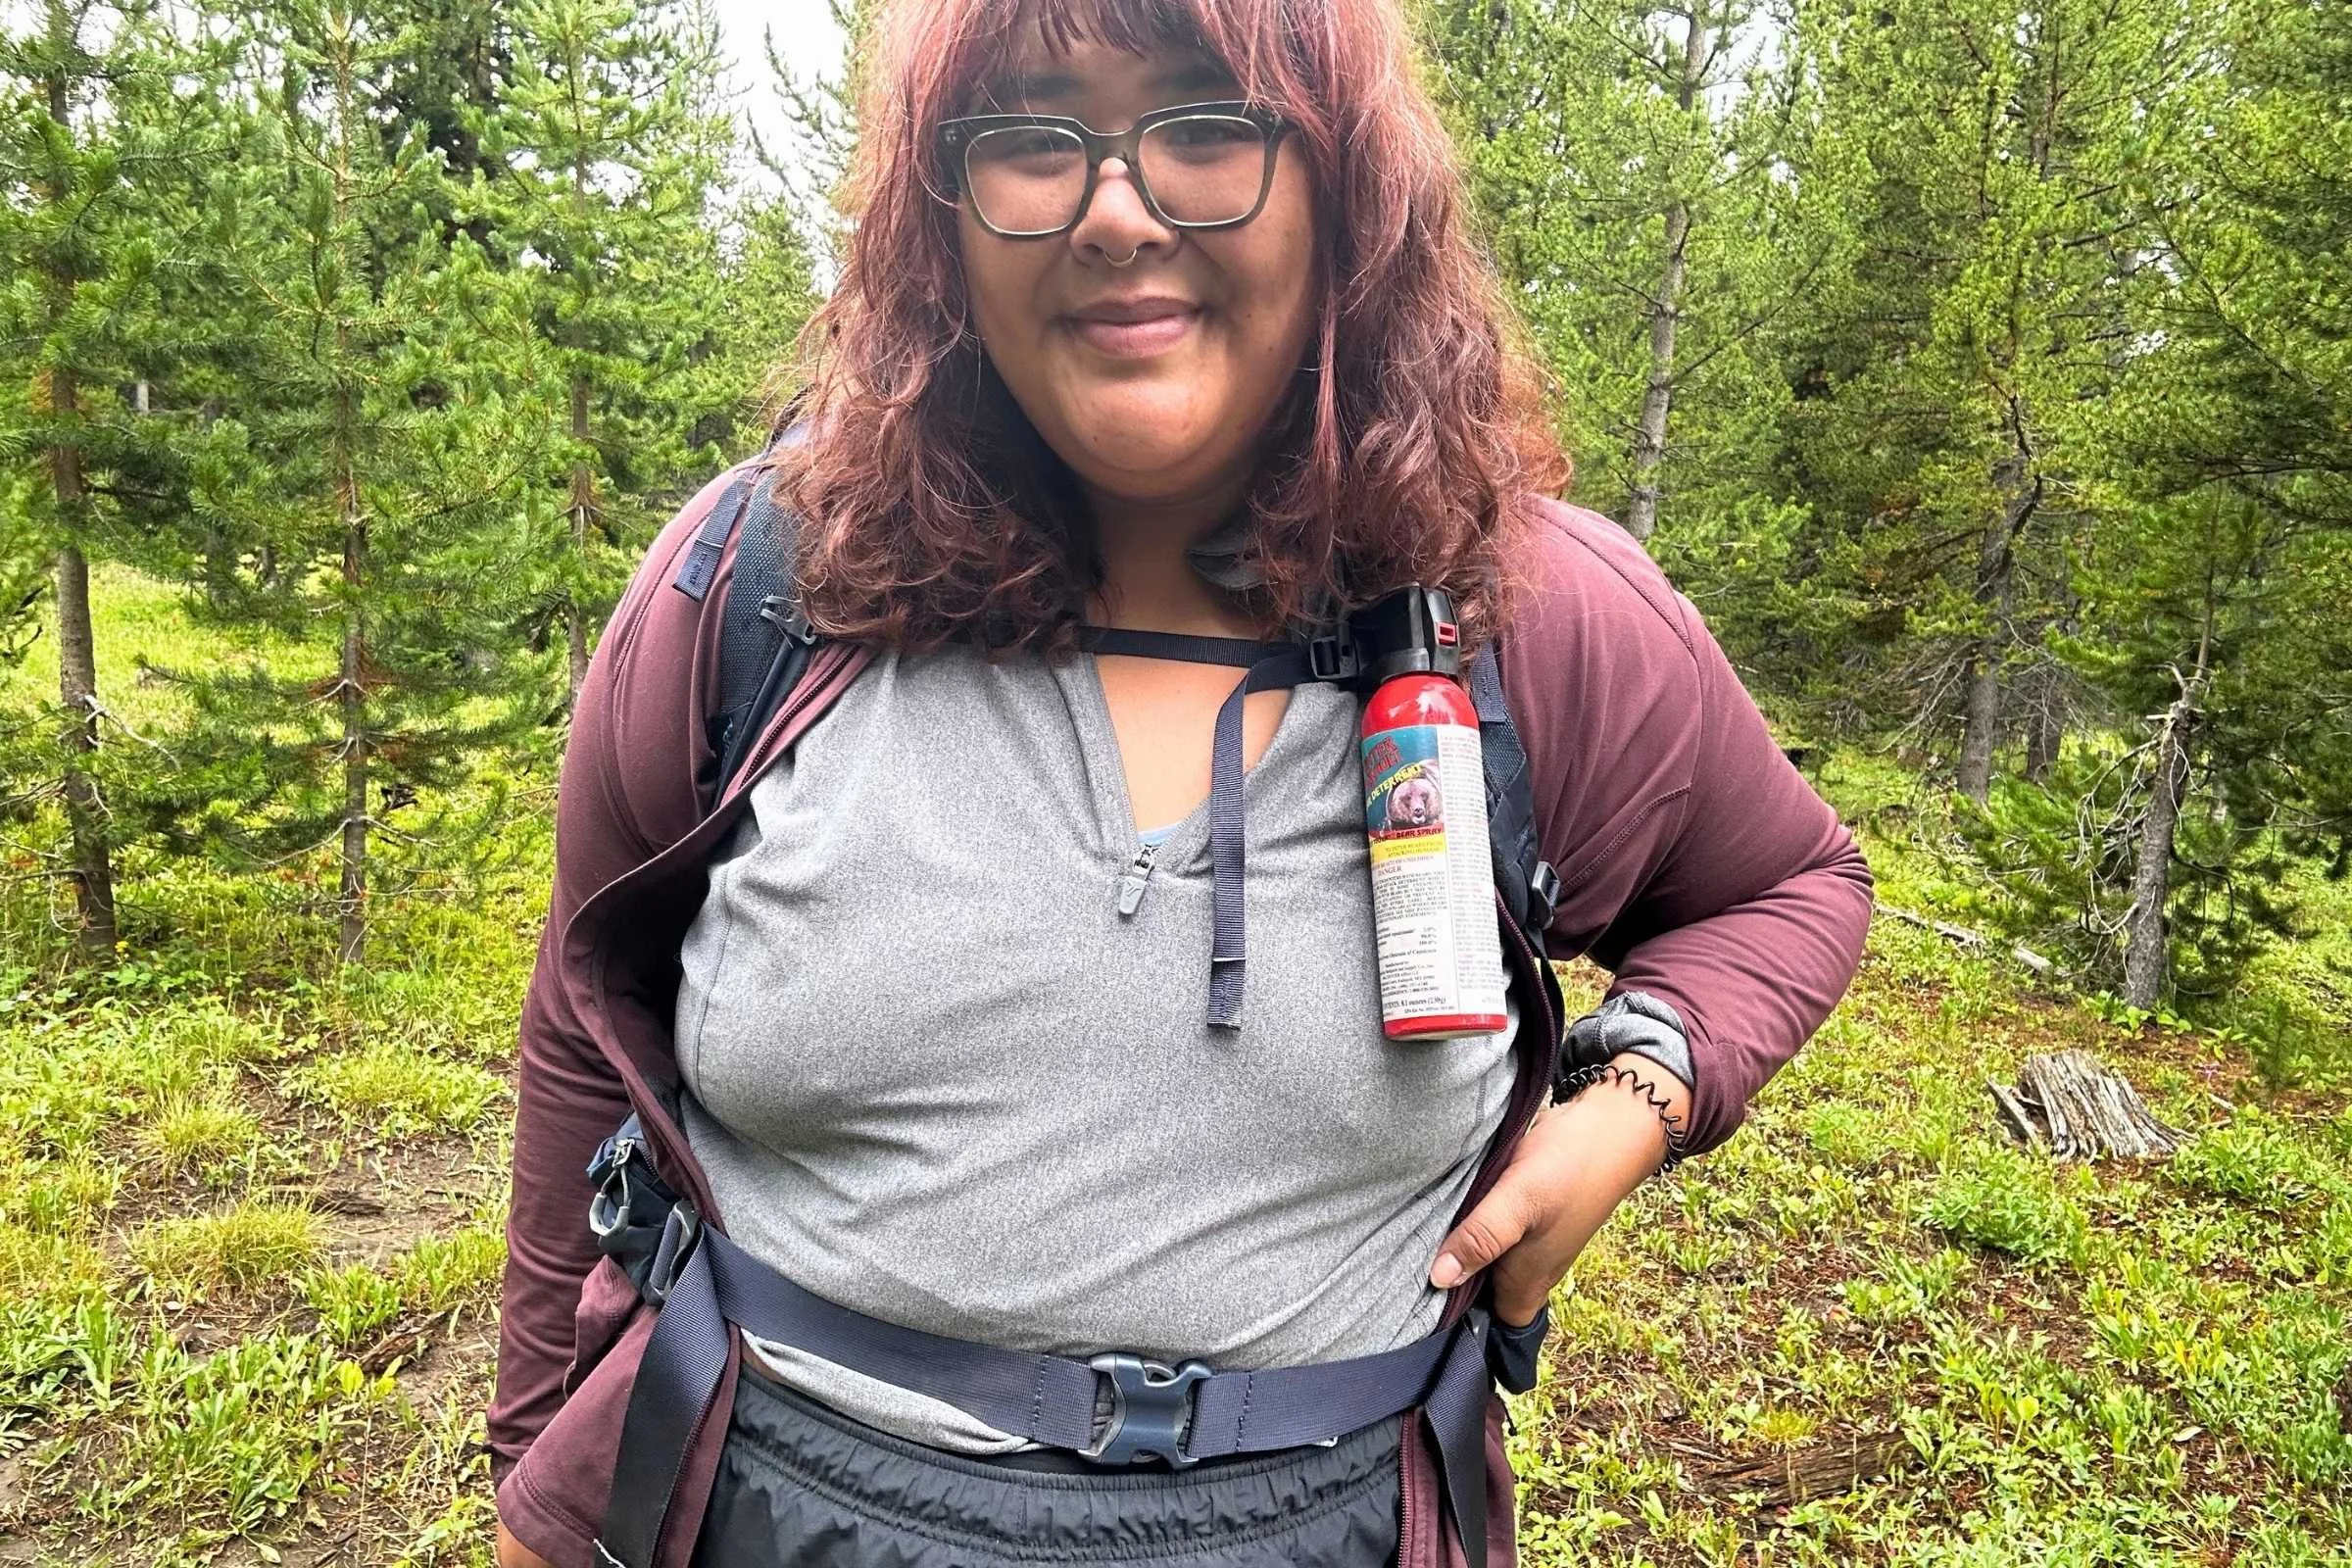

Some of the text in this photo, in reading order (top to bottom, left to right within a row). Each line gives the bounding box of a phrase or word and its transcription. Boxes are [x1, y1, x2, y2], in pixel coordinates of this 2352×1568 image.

[1371, 763, 1423, 802] DETERRENT
[1396, 827, 1442, 840] BEAR SPRAY
